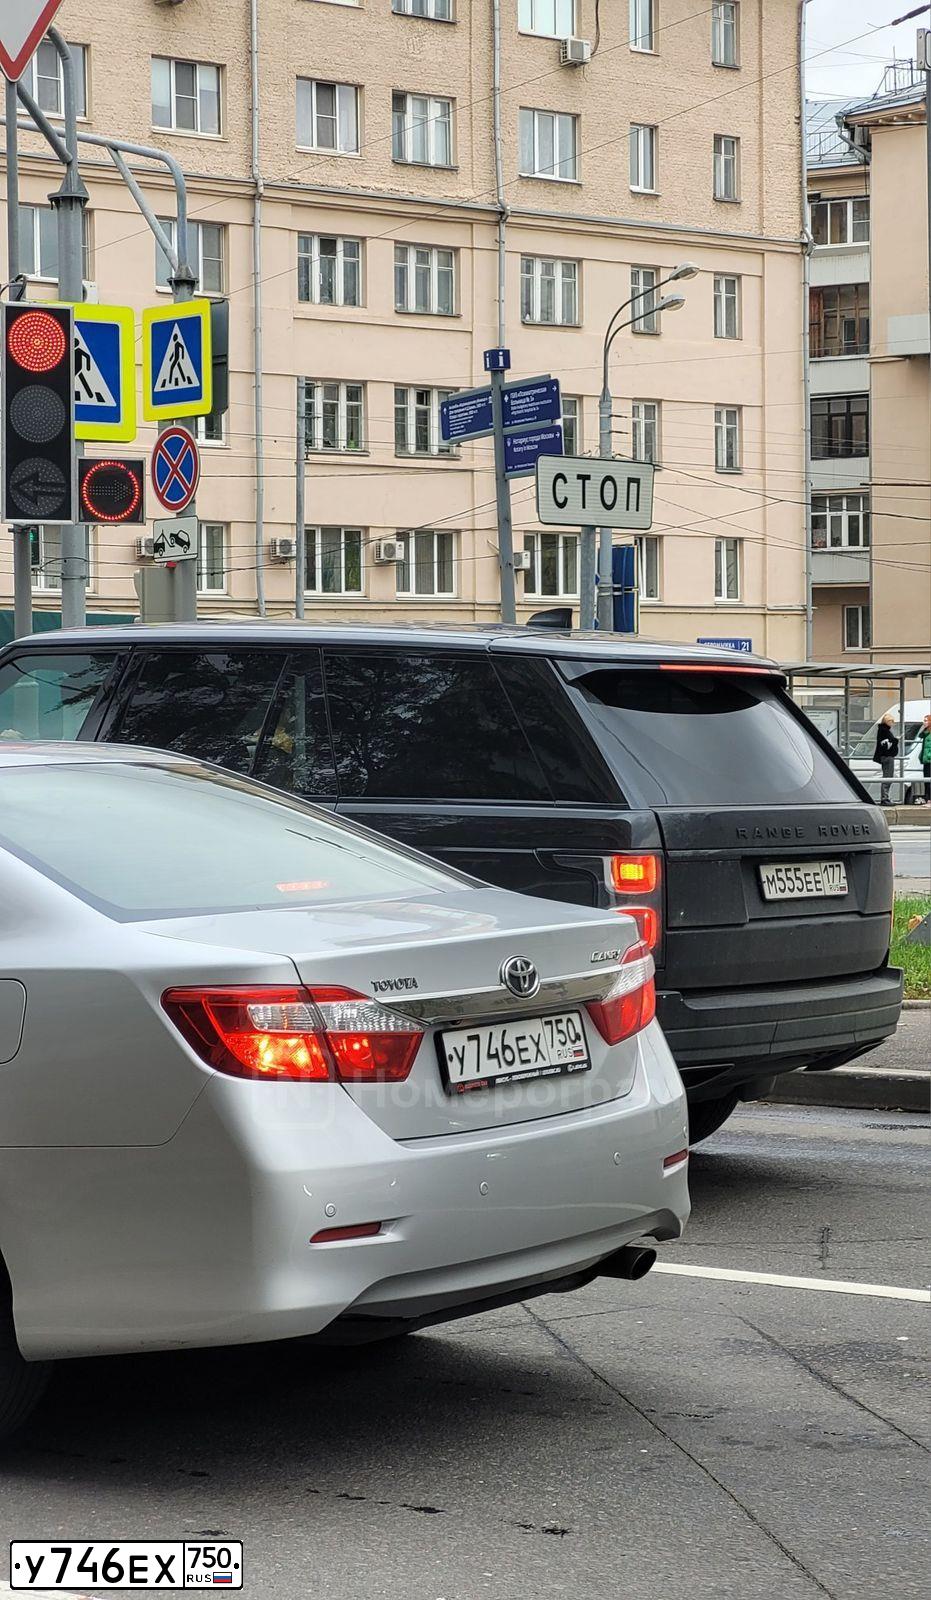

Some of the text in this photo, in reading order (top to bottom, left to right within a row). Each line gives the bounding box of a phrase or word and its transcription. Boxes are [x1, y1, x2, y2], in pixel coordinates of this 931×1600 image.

[552, 472, 641, 512] СТОП
[741, 641, 750, 651] 21
[736, 824, 871, 839] RANGE ROVER
[765, 864, 842, 894] М555ЕЕ 177
[371, 977, 418, 992] TOYOTA
[453, 1017, 578, 1076] У746ЕХ 750
[557, 1048, 573, 1061] RUS
